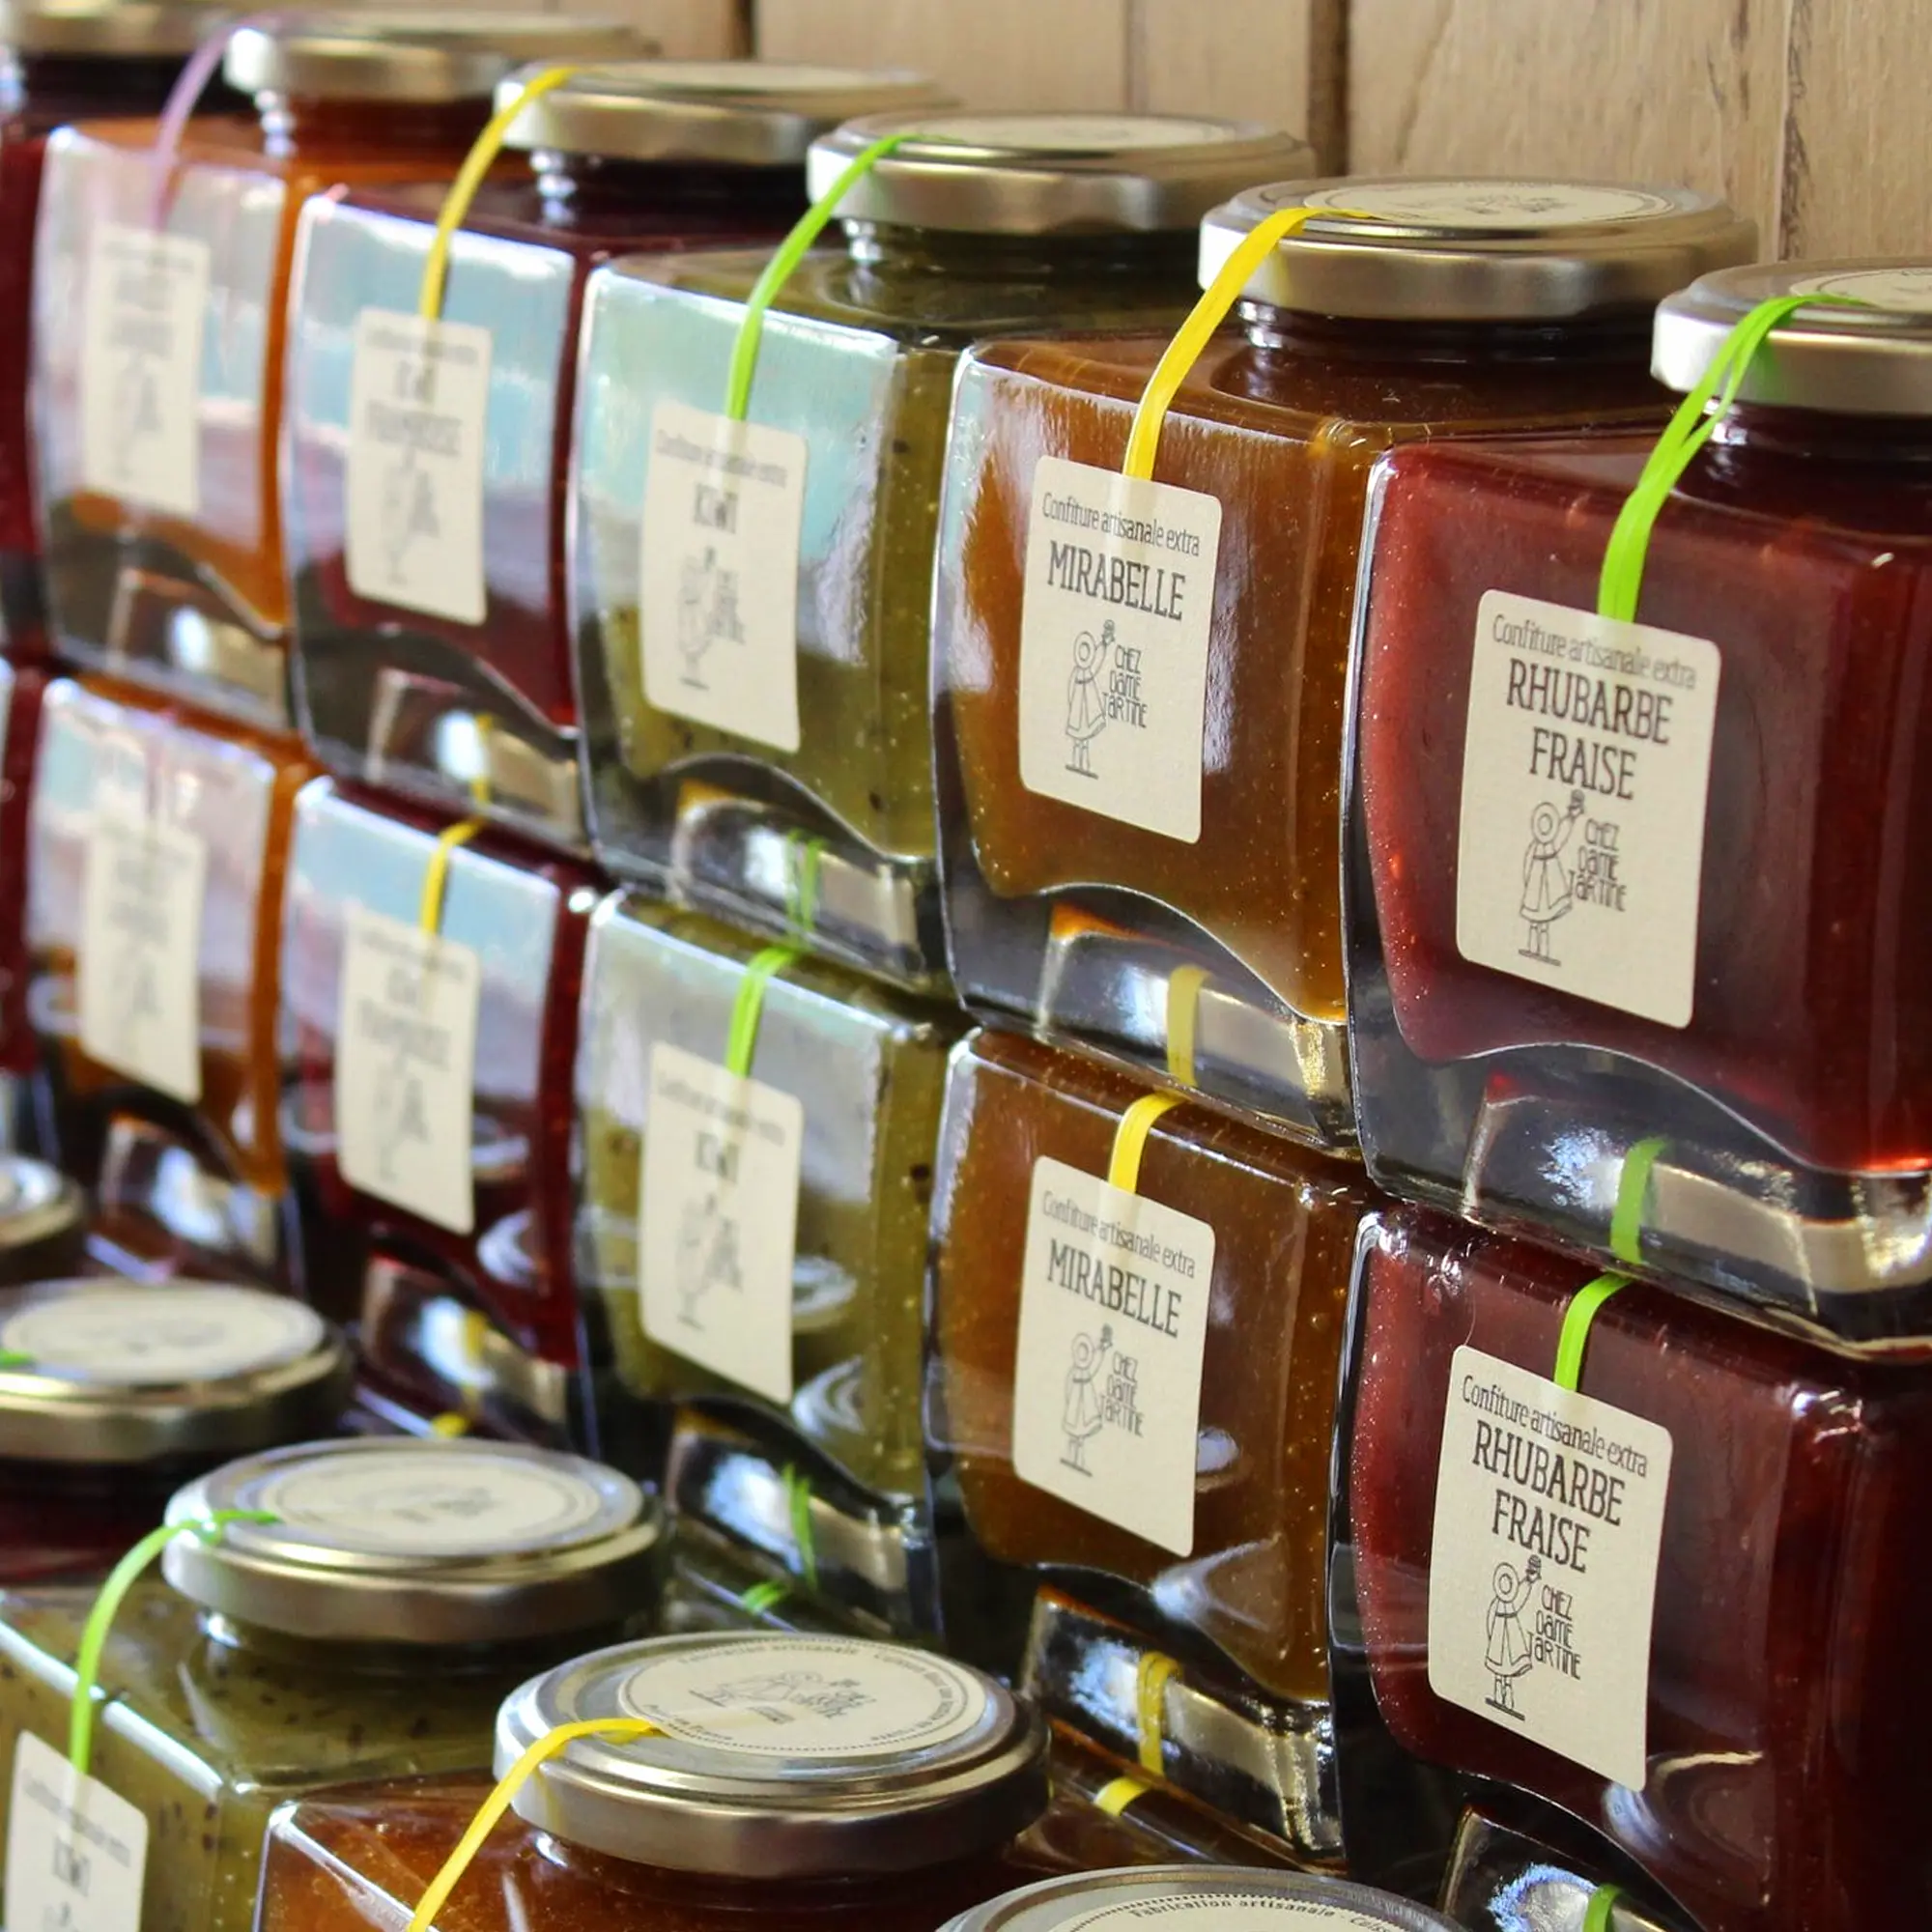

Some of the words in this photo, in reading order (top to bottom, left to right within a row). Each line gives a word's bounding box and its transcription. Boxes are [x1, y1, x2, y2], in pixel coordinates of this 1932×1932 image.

[1042, 493, 1099, 530] Confiture
[1101, 511, 1164, 547] artisanale
[1166, 526, 1201, 557] extra
[1047, 539, 1186, 621] MIRABELLE
[1115, 644, 1142, 673] CHEZ
[1492, 613, 1567, 657] Confiture
[1569, 638, 1650, 677] artisanale
[1653, 658, 1697, 691] extra
[1506, 657, 1674, 746] RHUBARBE
[1529, 725, 1637, 801] FRAISE
[1042, 1190, 1098, 1236] Confiture
[1098, 1220, 1160, 1263] artisanale
[1162, 1247, 1196, 1279] extra
[1047, 1237, 1182, 1339] MIRABELLE
[1462, 1375, 1528, 1428] Confiture
[1530, 1408, 1605, 1460] artisanale
[1606, 1440, 1649, 1479] extra
[1472, 1419, 1626, 1527] RHUBARBE
[1492, 1488, 1591, 1574] FRAISE
[1542, 1584, 1573, 1621] CHEZ
[1129, 1899, 1232, 1918] Fabrication
[1239, 1900, 1335, 1917] artisanale
